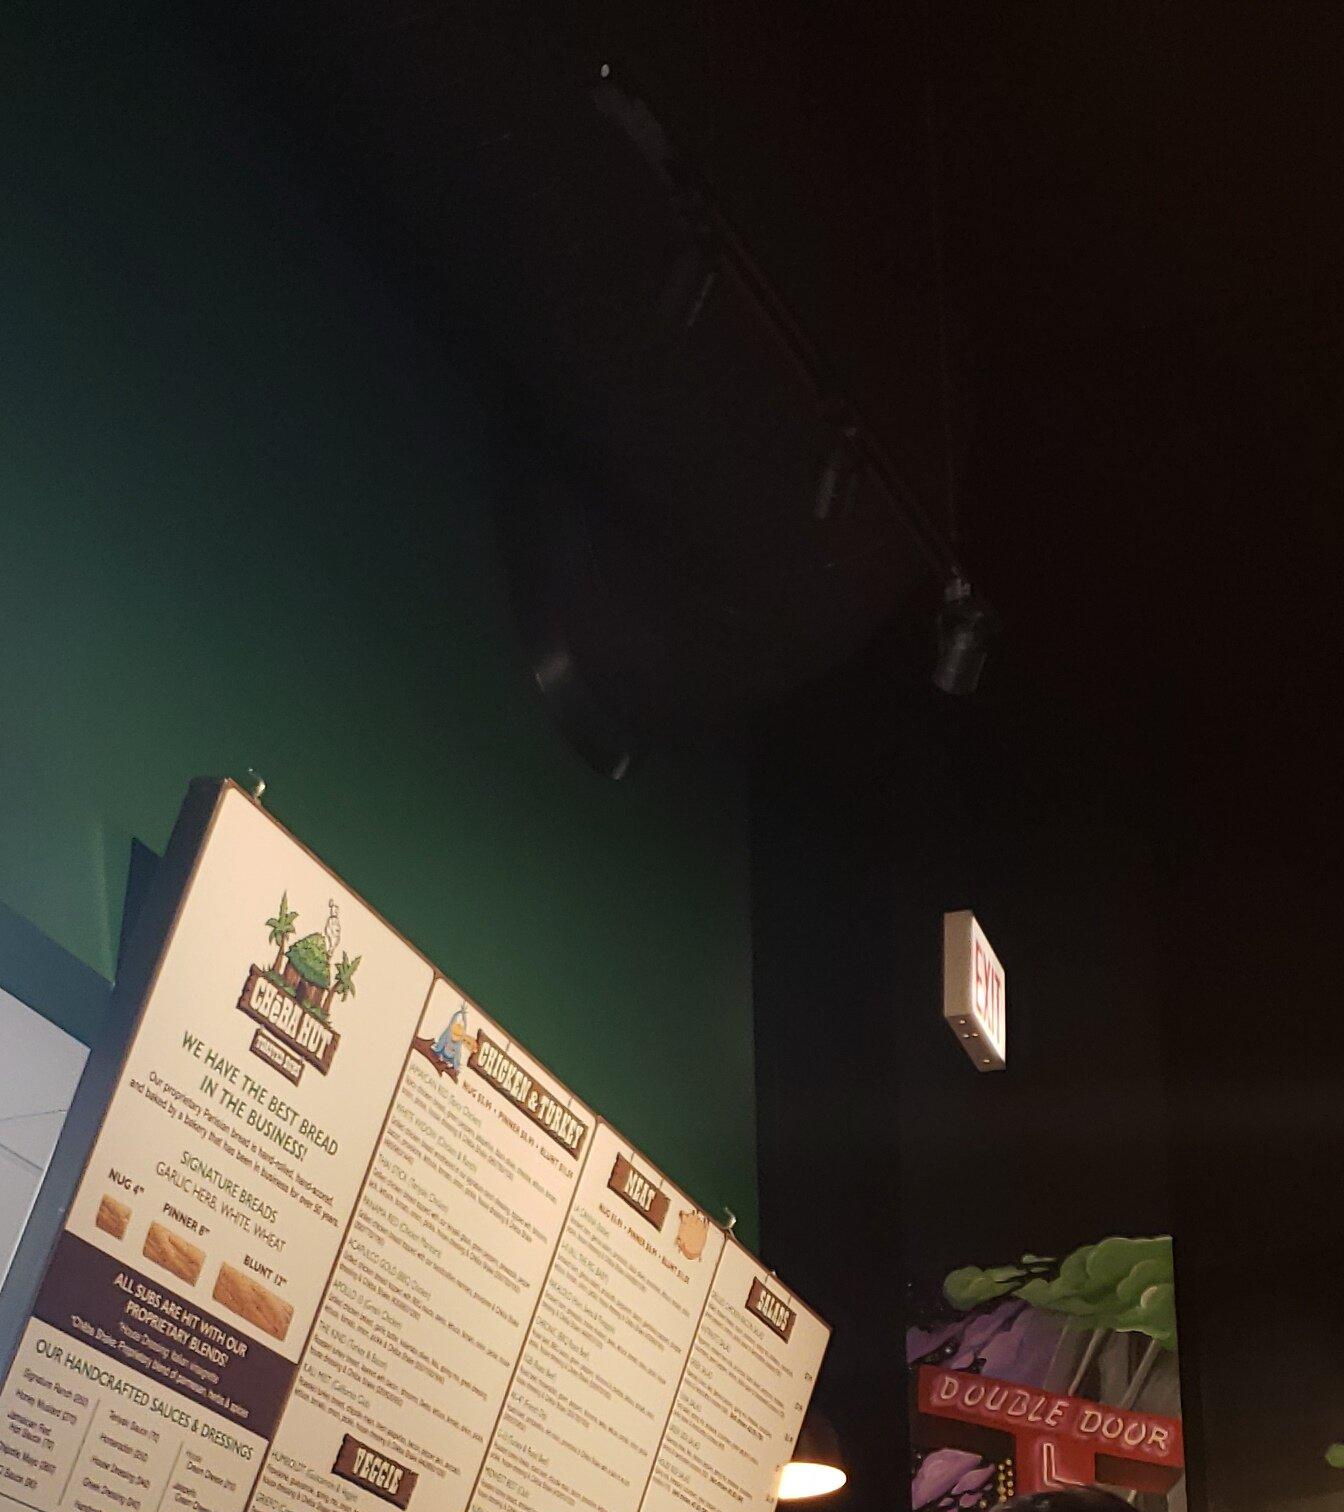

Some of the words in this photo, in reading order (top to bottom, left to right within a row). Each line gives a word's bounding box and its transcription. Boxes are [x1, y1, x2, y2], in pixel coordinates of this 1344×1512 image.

[976, 938, 1002, 1044] EXIT
[295, 1012, 333, 1063] HUT
[147, 1070, 163, 1088] Our
[230, 1127, 250, 1149] bread
[180, 1030, 204, 1059] WE
[203, 1047, 240, 1085] HAVE
[239, 1073, 267, 1105] THE
[267, 1094, 299, 1128] BEST
[298, 1117, 339, 1157] BREAD
[199, 1074, 218, 1099] IN
[218, 1088, 246, 1118] THE
[246, 1108, 307, 1162] BUSINESS!
[476, 1040, 531, 1105] CHICKEN
[526, 1084, 542, 1114] &
[536, 1093, 584, 1150] TURKEY
[107, 1168, 133, 1192] NUG
[154, 1159, 191, 1193] GARLIC
[252, 1223, 286, 1254] WHEAT
[162, 1202, 198, 1232] PINNER
[180, 1150, 239, 1198] SIGNATURE
[238, 1188, 277, 1224] BREADS
[623, 1169, 656, 1213] MEAT
[243, 1254, 273, 1280] BLUNT
[113, 1271, 137, 1295] ALL
[134, 1283, 162, 1309] SUBS
[160, 1298, 182, 1321] ARE
[181, 1310, 199, 1330] HIT
[198, 1320, 224, 1344] WITH
[220, 1333, 248, 1358] OUR
[125, 1300, 190, 1346] PROPRIETARY
[188, 1335, 229, 1368] BLENDS!
[756, 1288, 790, 1332] SALADS
[34, 1337, 64, 1364] OUR
[63, 1352, 151, 1408] HANDCRAFTED
[149, 1396, 191, 1429] SAUCES
[189, 1417, 200, 1433] &
[199, 1422, 253, 1460] DRESSINGS
[940, 1376, 1069, 1427] DOUBLE
[1080, 1409, 1168, 1450] DOOR
[350, 1446, 403, 1495] VEGGIE
